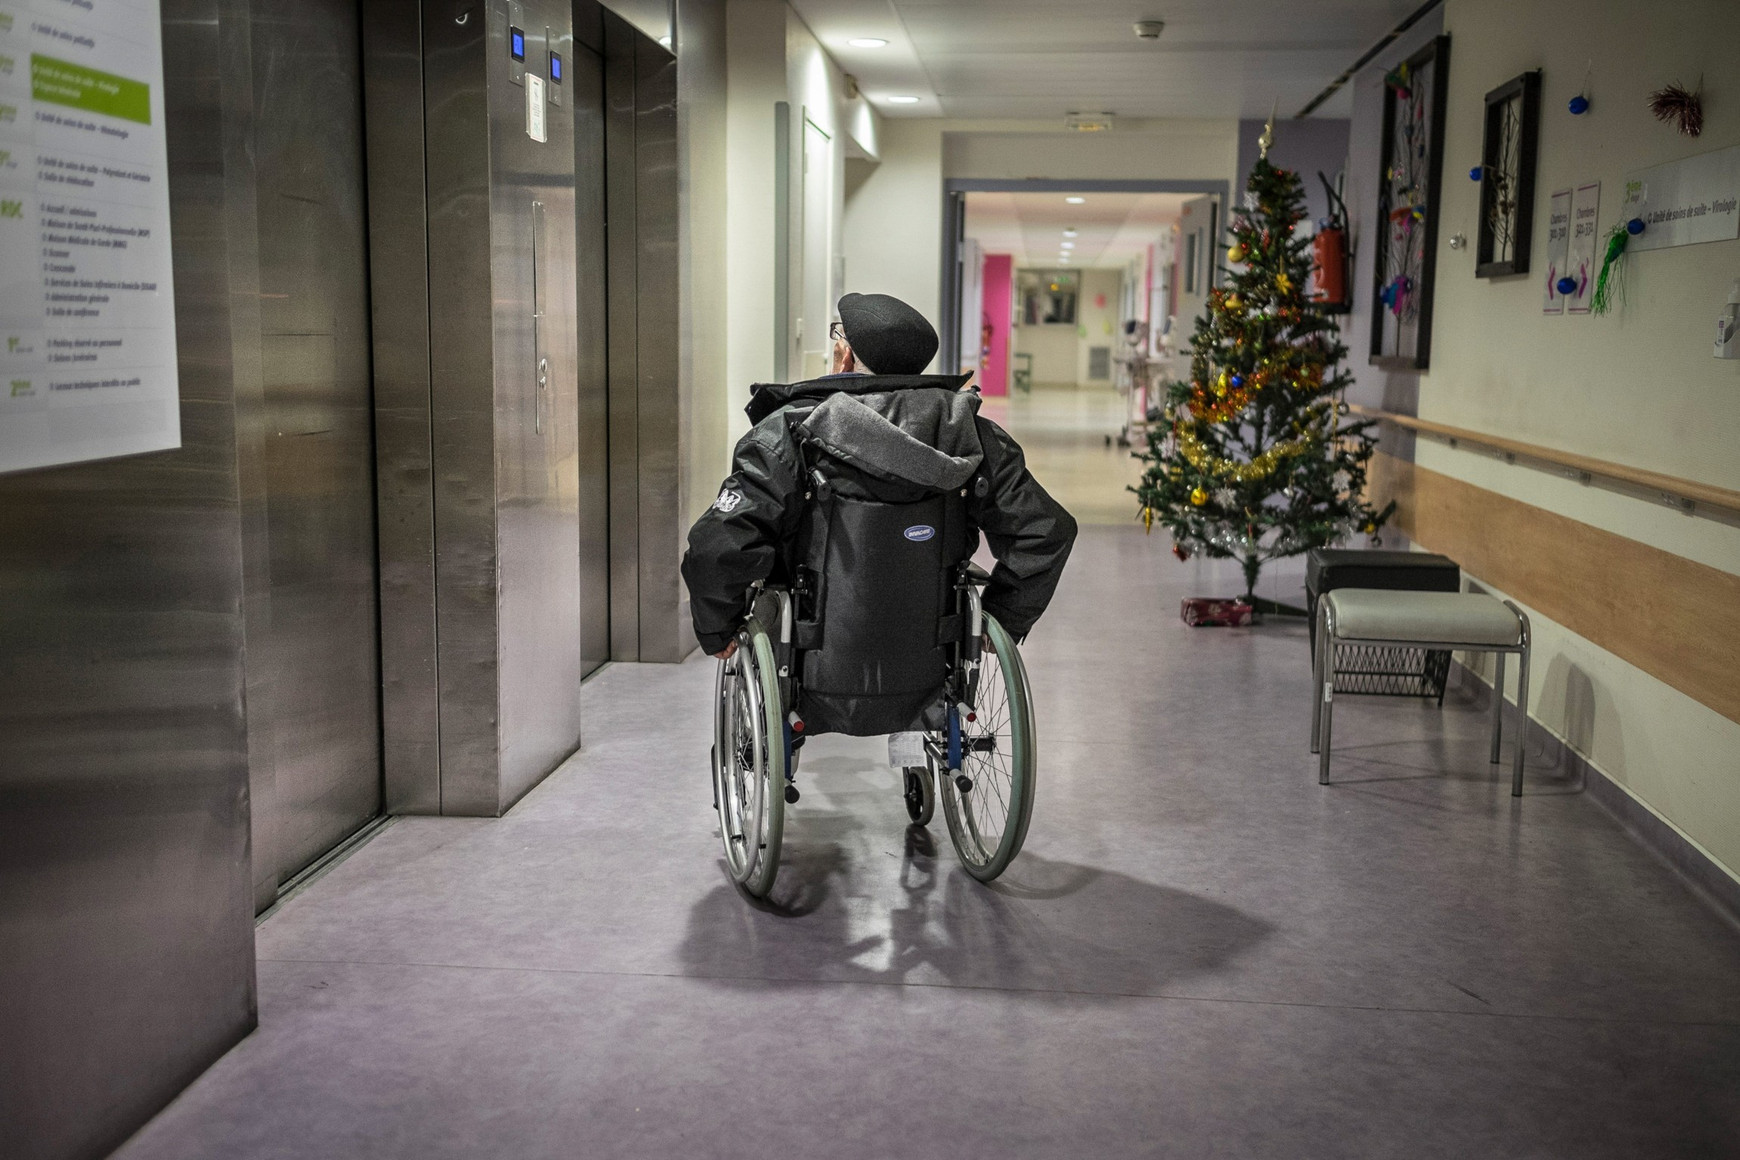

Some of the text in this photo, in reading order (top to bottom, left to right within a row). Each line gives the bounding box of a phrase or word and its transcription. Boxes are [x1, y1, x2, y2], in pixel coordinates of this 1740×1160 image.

[1666, 208, 1672, 221] de
[1672, 205, 1686, 220] soins
[1686, 204, 1693, 218] de
[1693, 202, 1707, 217] suite
[1712, 196, 1737, 215] Virologie
